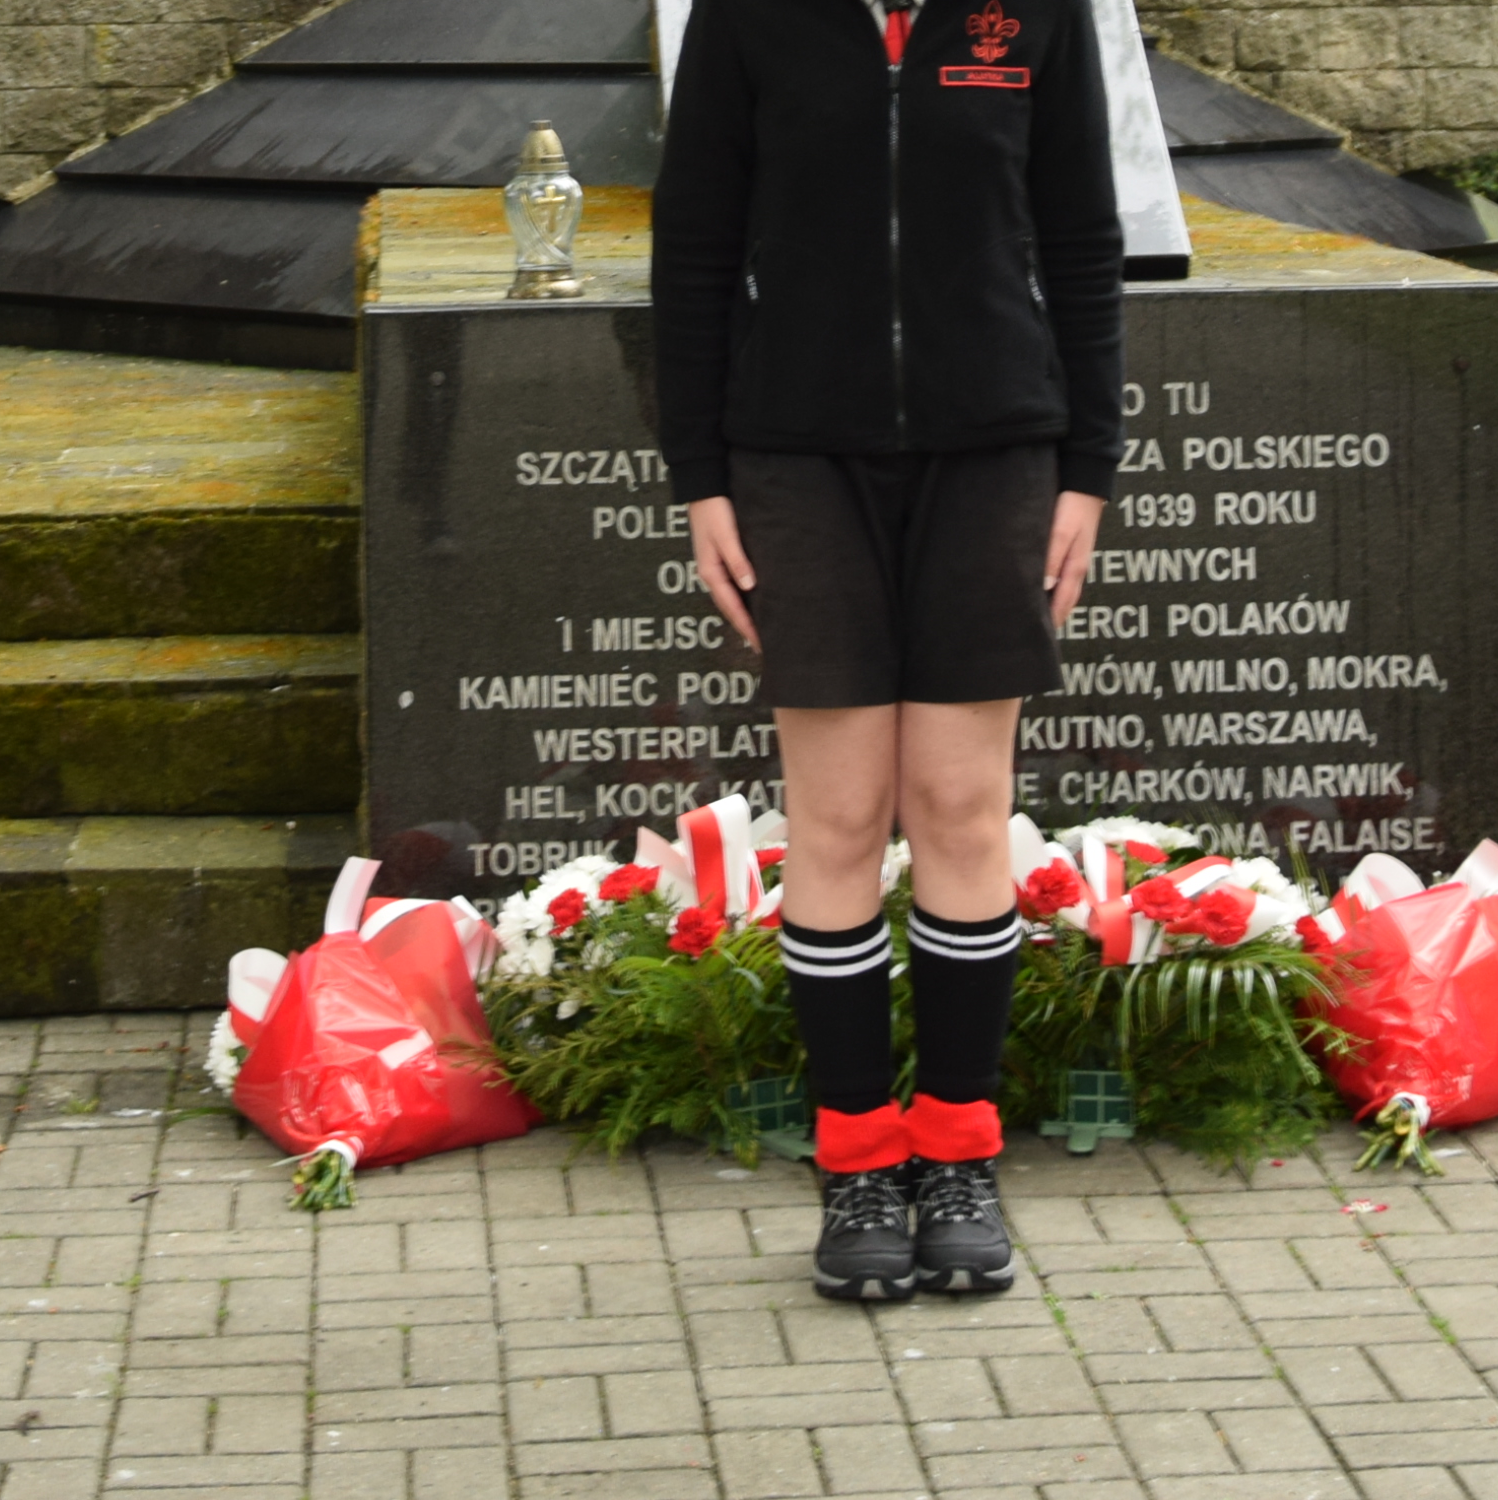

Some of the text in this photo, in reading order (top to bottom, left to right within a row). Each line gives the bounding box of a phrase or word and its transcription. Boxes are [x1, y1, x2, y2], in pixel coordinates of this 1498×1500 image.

[1162, 381, 1211, 416] TU
[1183, 433, 1390, 472] POLSKIEGO
[1118, 492, 1197, 528] 1939
[1214, 490, 1317, 526] ROKU
[592, 615, 724, 652] MIEJSC
[1167, 594, 1351, 639] POLAKÓW
[678, 670, 762, 707] POD
[1171, 657, 1298, 698] WILNO,
[1307, 653, 1448, 693] MOKRA,
[1020, 713, 1154, 754] KUTNO,
[1162, 708, 1378, 748] WARSZAWA,
[505, 786, 586, 824] HEL,
[1059, 760, 1253, 807] CHARKÓW,
[1263, 761, 1415, 800] NARWIK,
[1186, 820, 1281, 859] ONA,
[1290, 816, 1446, 856] FALAISE,
